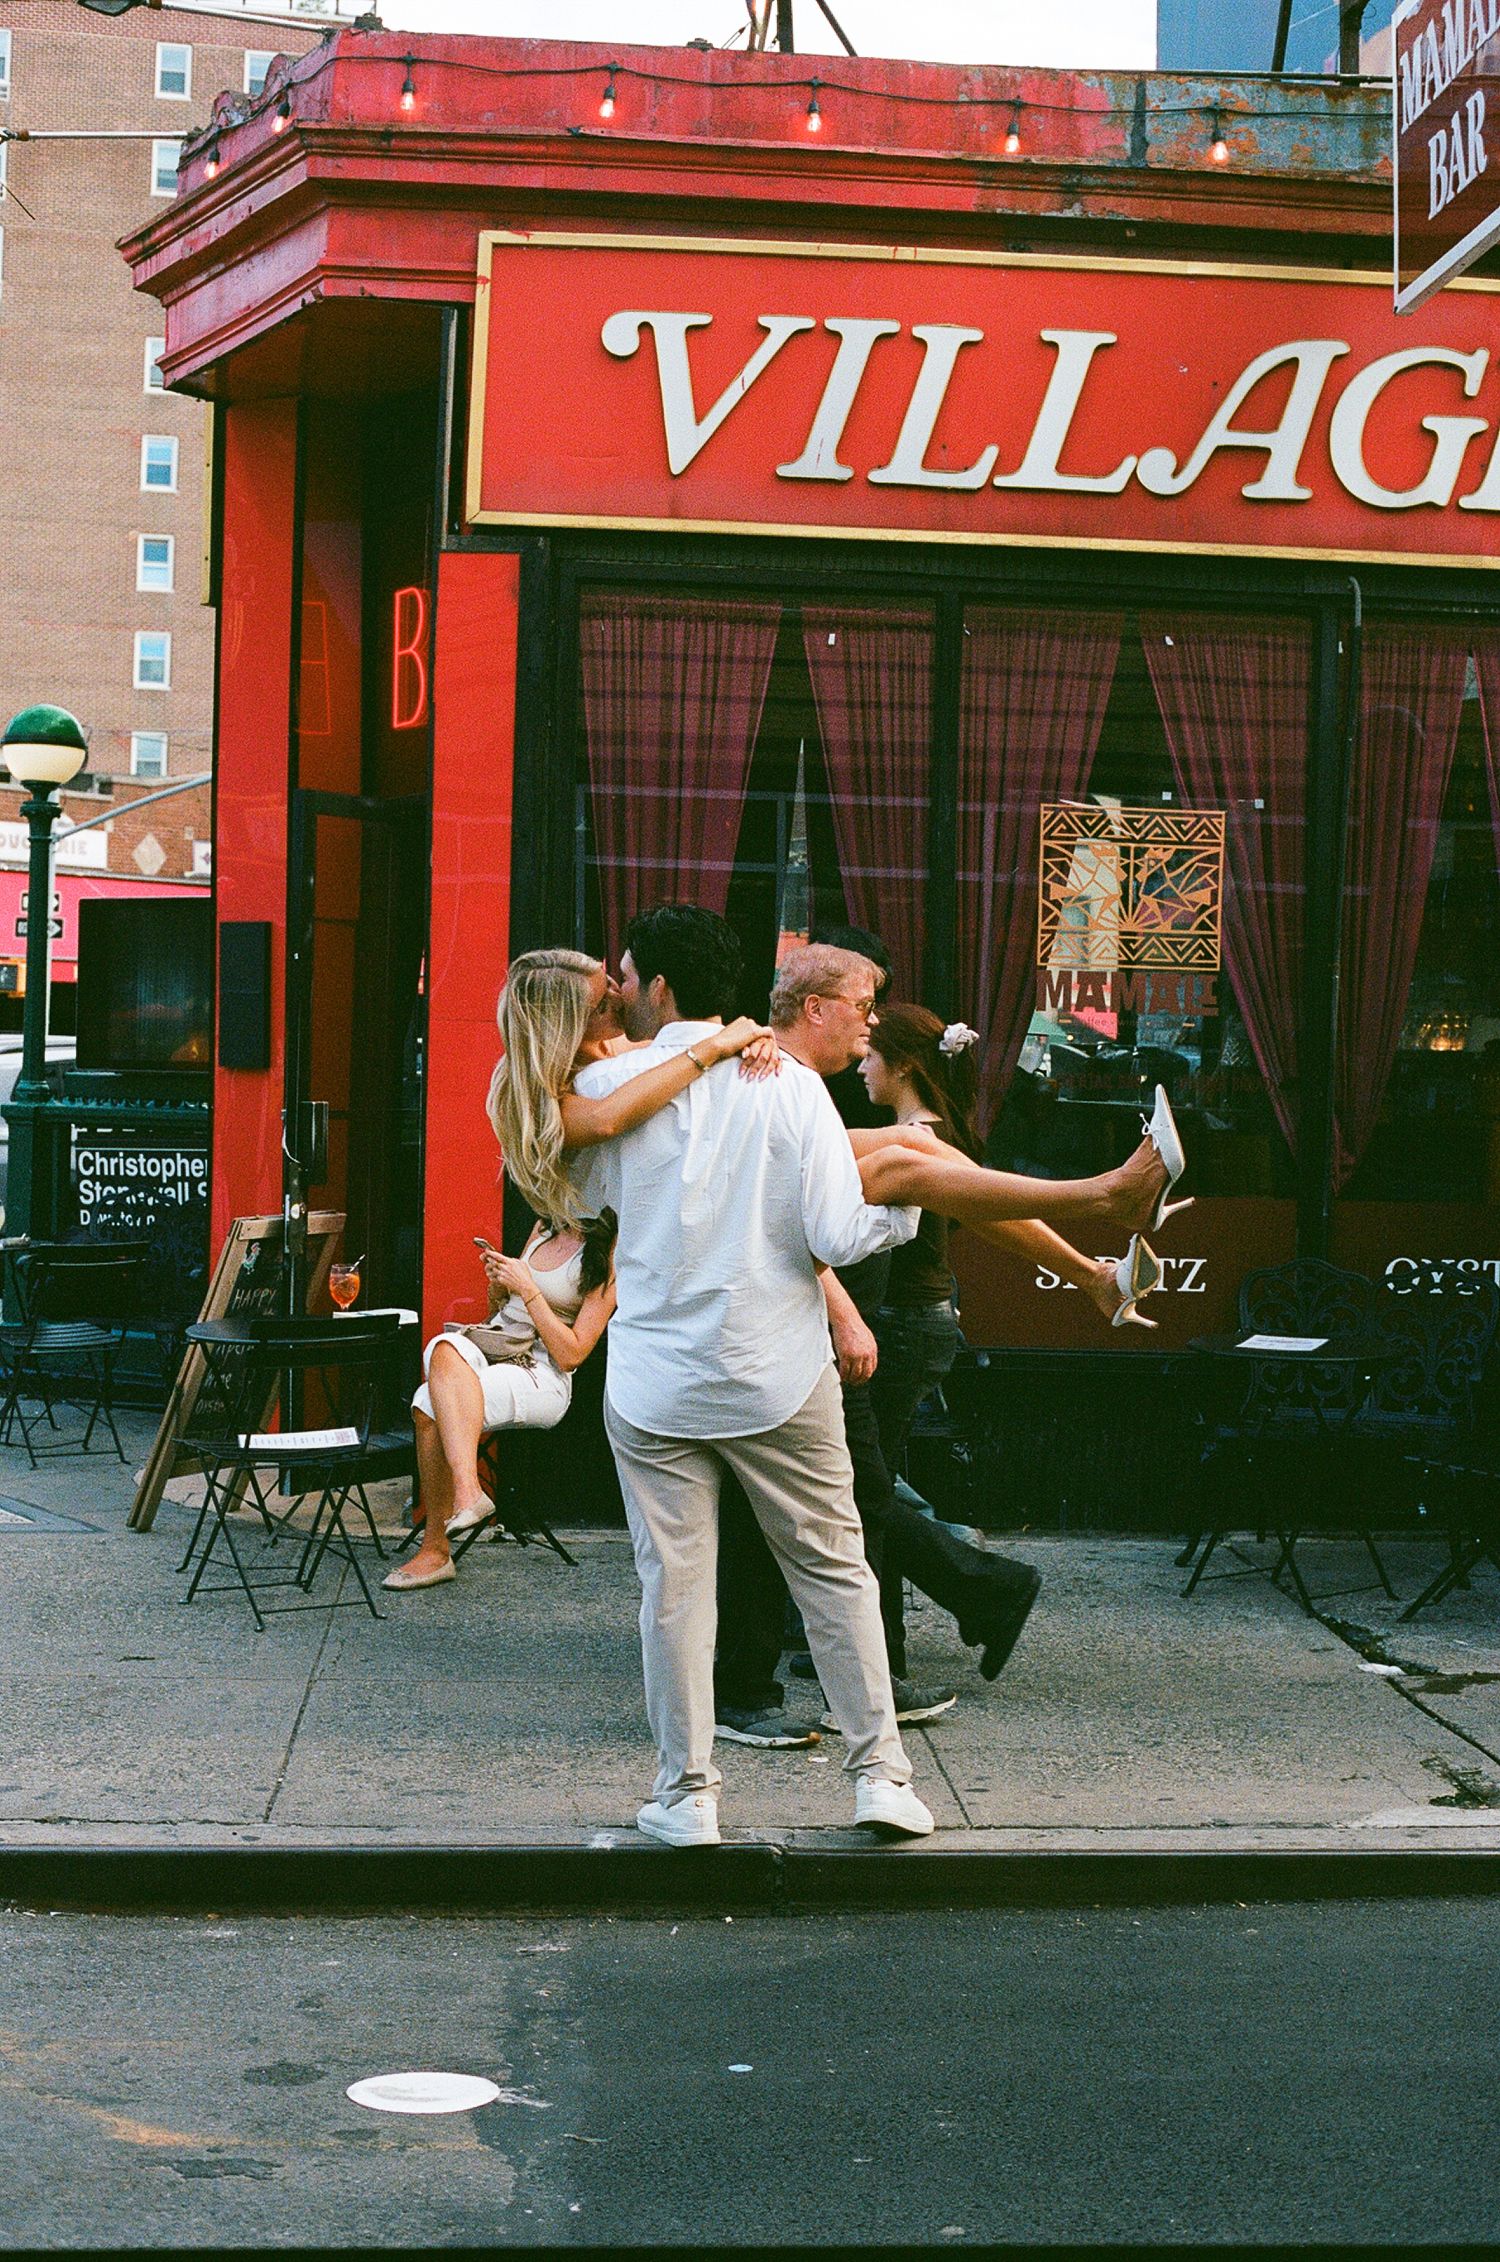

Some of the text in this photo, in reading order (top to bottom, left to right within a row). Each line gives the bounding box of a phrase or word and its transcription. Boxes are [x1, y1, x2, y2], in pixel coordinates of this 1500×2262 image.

[1428, 87, 1488, 221] BAR
[601, 309, 1500, 513] VILLAG
[78, 1151, 208, 1184] Christophe
[231, 1288, 277, 1313] HAPPY
